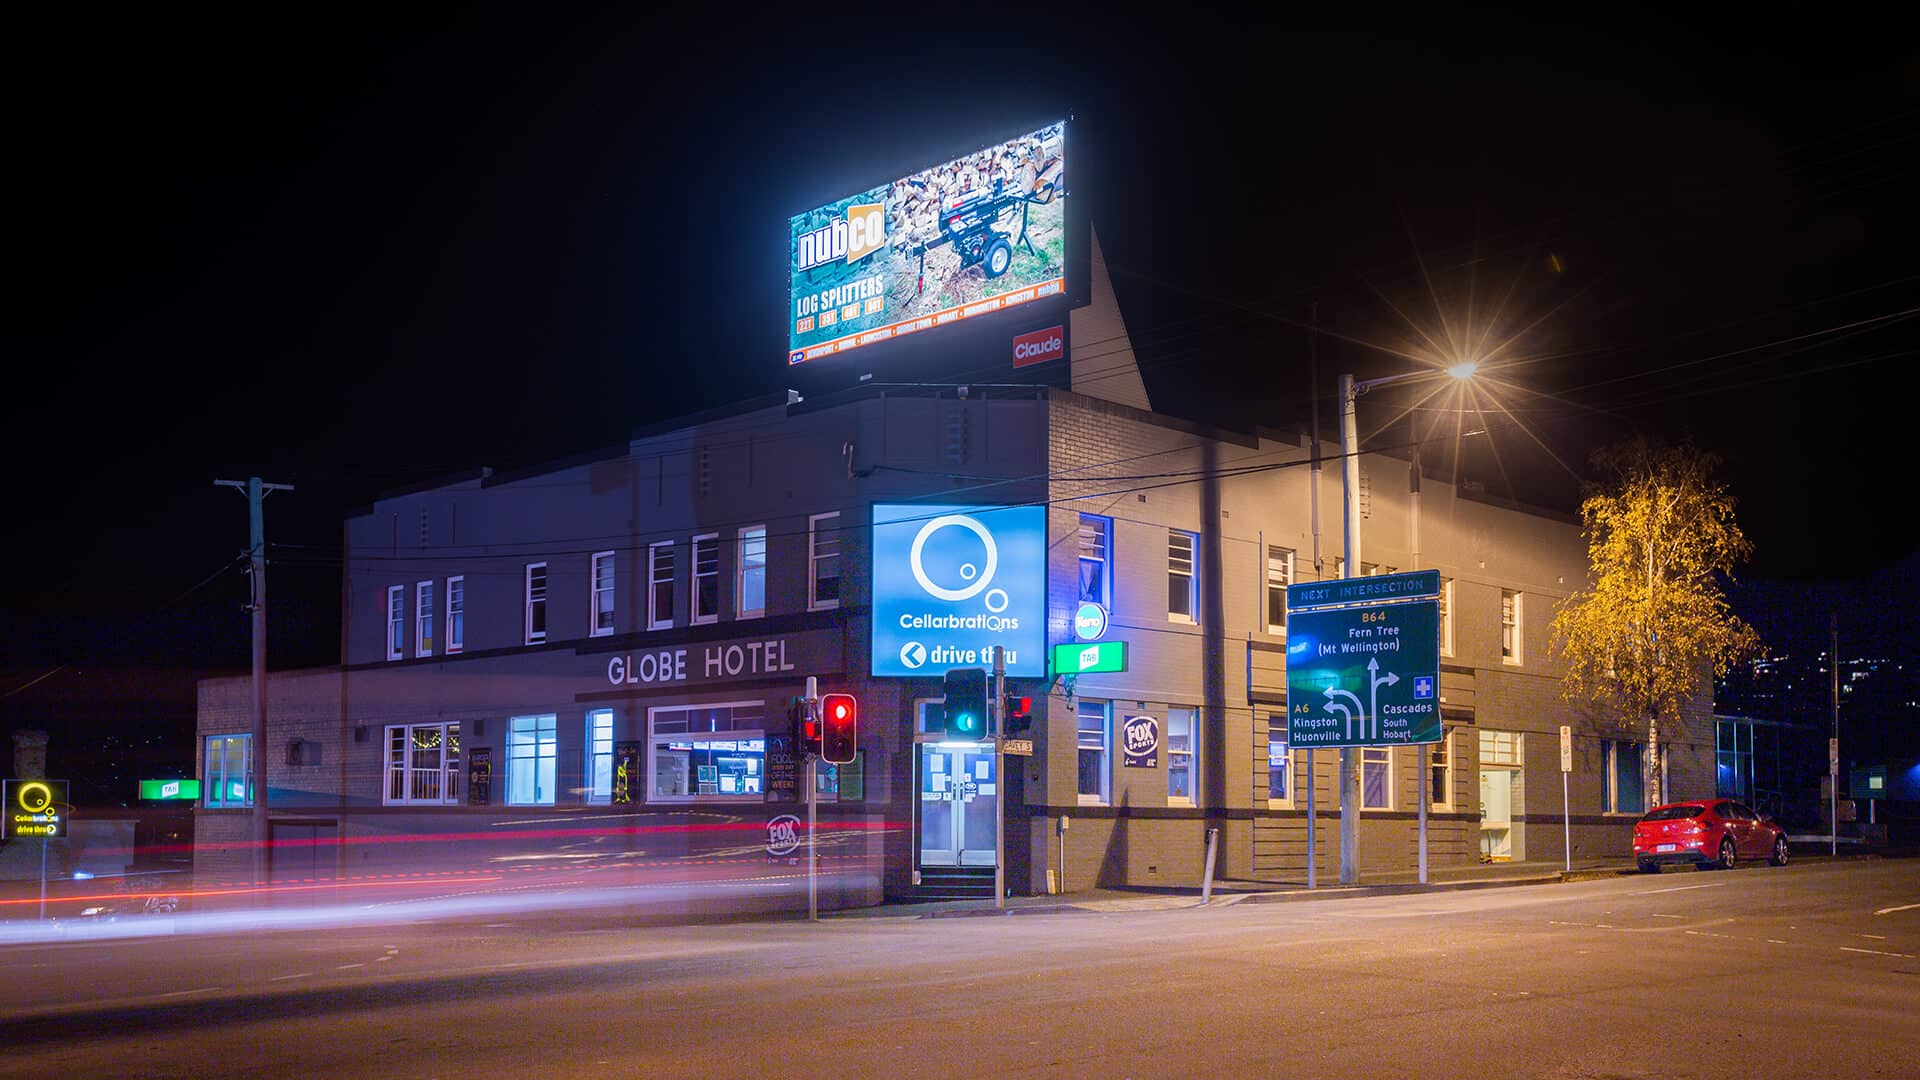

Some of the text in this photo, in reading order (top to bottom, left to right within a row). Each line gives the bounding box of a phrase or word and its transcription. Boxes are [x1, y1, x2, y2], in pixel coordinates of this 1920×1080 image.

[799, 210, 883, 269] nubco
[797, 274, 884, 318] LOG SPLITTERS
[1016, 336, 1061, 359] Claude
[1301, 580, 1423, 601] NEXT INTERSECTION
[1362, 611, 1386, 623] B64
[1349, 626, 1400, 639] Fern Tree
[931, 645, 976, 664] drive
[1318, 638, 1400, 656] (Mt Wellington)
[608, 640, 795, 685] GLOBE HOTEL
[1082, 653, 1097, 663] TAB
[1294, 704, 1309, 713] A6
[1383, 704, 1433, 714] Cascades
[1294, 718, 1338, 730] Kingston
[1383, 718, 1408, 728] South
[1128, 722, 1153, 744] FOX
[1294, 731, 1341, 742] Huonville
[1383, 730, 1412, 740] Hobart
[770, 821, 796, 843] FOX
